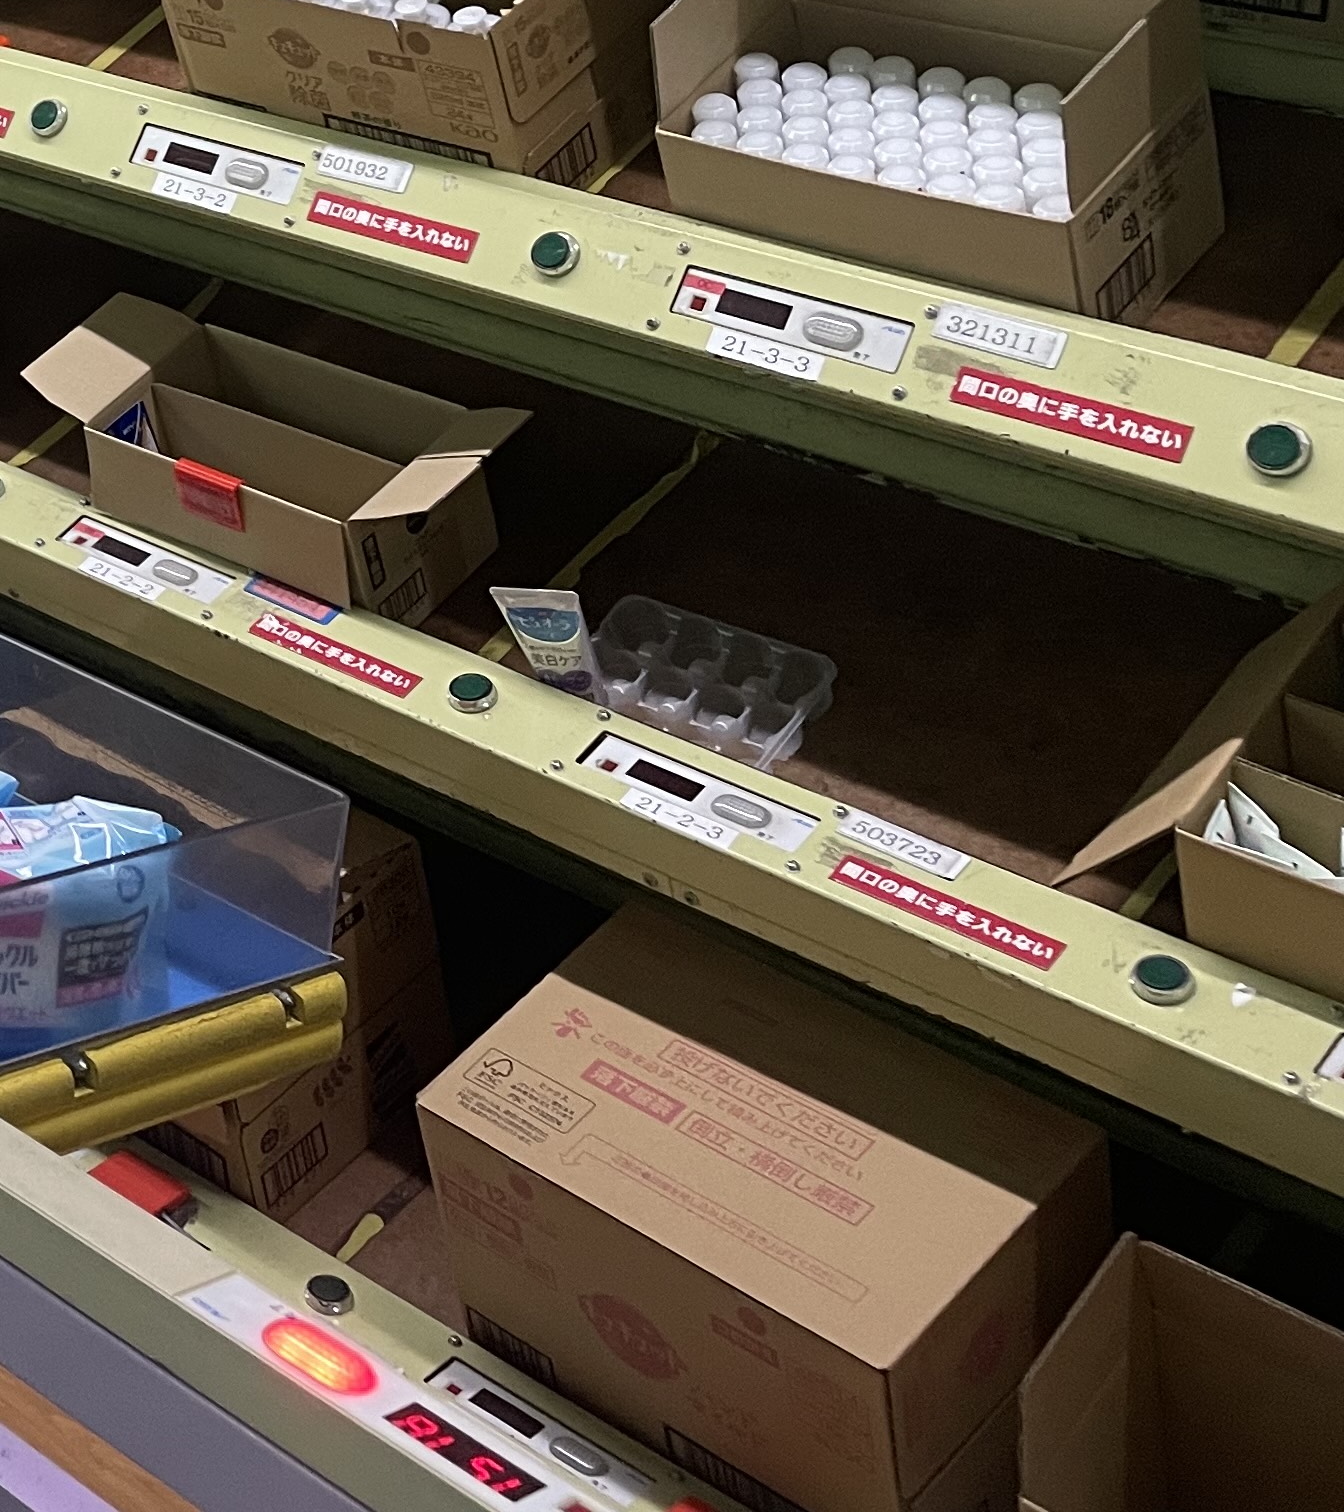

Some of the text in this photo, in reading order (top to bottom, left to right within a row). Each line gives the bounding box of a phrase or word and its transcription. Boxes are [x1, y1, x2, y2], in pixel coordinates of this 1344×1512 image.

[322, 153, 389, 180] 501932
[162, 179, 227, 208] 21-3-2
[313, 197, 471, 251] 間口の奥に手を入れない
[723, 335, 810, 374] 21-3-3
[945, 314, 1037, 355] 321311
[957, 377, 1182, 449] 間口の奥に手を入れない
[89, 562, 155, 595] 21-2-2
[530, 655, 582, 668] 美白ケア
[634, 796, 724, 840] 21-2-3
[850, 820, 942, 867] 503723
[841, 861, 1054, 960] 間口の奥に手を入れない
